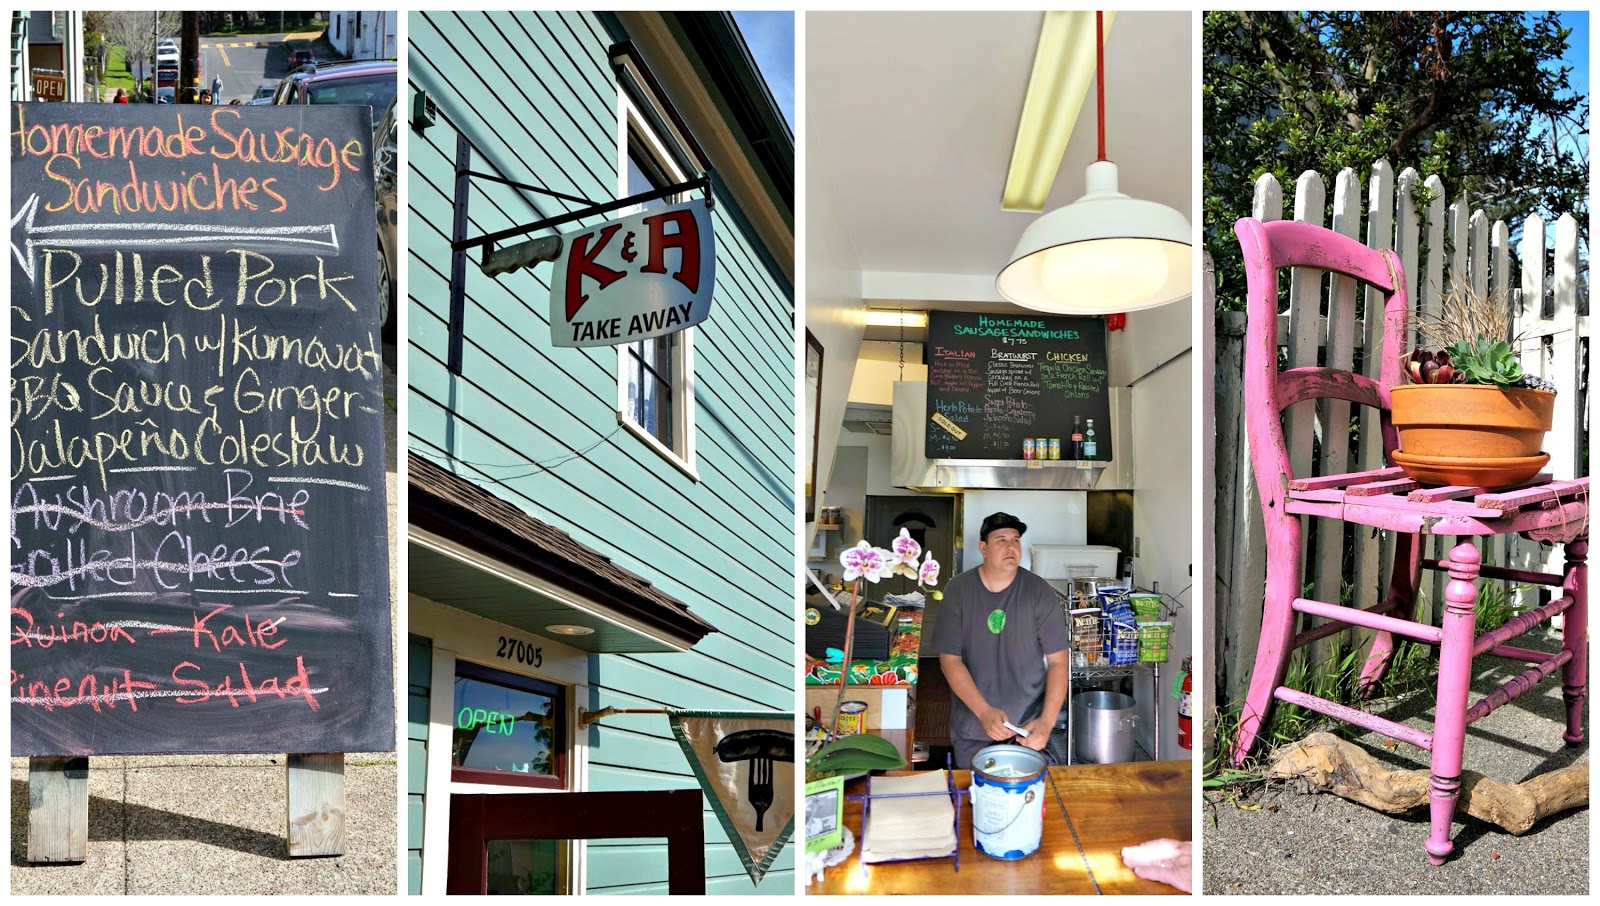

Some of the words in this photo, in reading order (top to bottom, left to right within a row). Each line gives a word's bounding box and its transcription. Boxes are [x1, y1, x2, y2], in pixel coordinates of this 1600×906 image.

[36, 79, 64, 97] OPEN
[210, 108, 363, 191] Sausage
[45, 153, 287, 214] Sandwiches
[42, 249, 223, 315] Pulled
[226, 249, 357, 312] Pork
[571, 318, 621, 342] TAKE
[628, 301, 693, 336] AWAY
[954, 325, 1010, 336] SAUSAGE
[1010, 328, 1080, 339] SANDWICHES
[979, 315, 1046, 329] HOMEMADE
[934, 346, 976, 358] ITALIAN
[991, 348, 1038, 360] BRATWURST
[1046, 351, 1089, 362] CHICKEN
[87, 367, 201, 420] Sauce
[936, 399, 958, 413] Herb
[958, 400, 983, 413] Potato
[1064, 390, 1090, 399] Onions
[937, 416, 951, 428] SOLD
[950, 426, 962, 436] OUT
[223, 468, 309, 530] Brie
[154, 531, 301, 589] Cheese
[192, 604, 287, 652] Kale
[497, 636, 543, 668] 27005
[172, 655, 320, 712] Salad
[458, 707, 515, 736] OPEN
